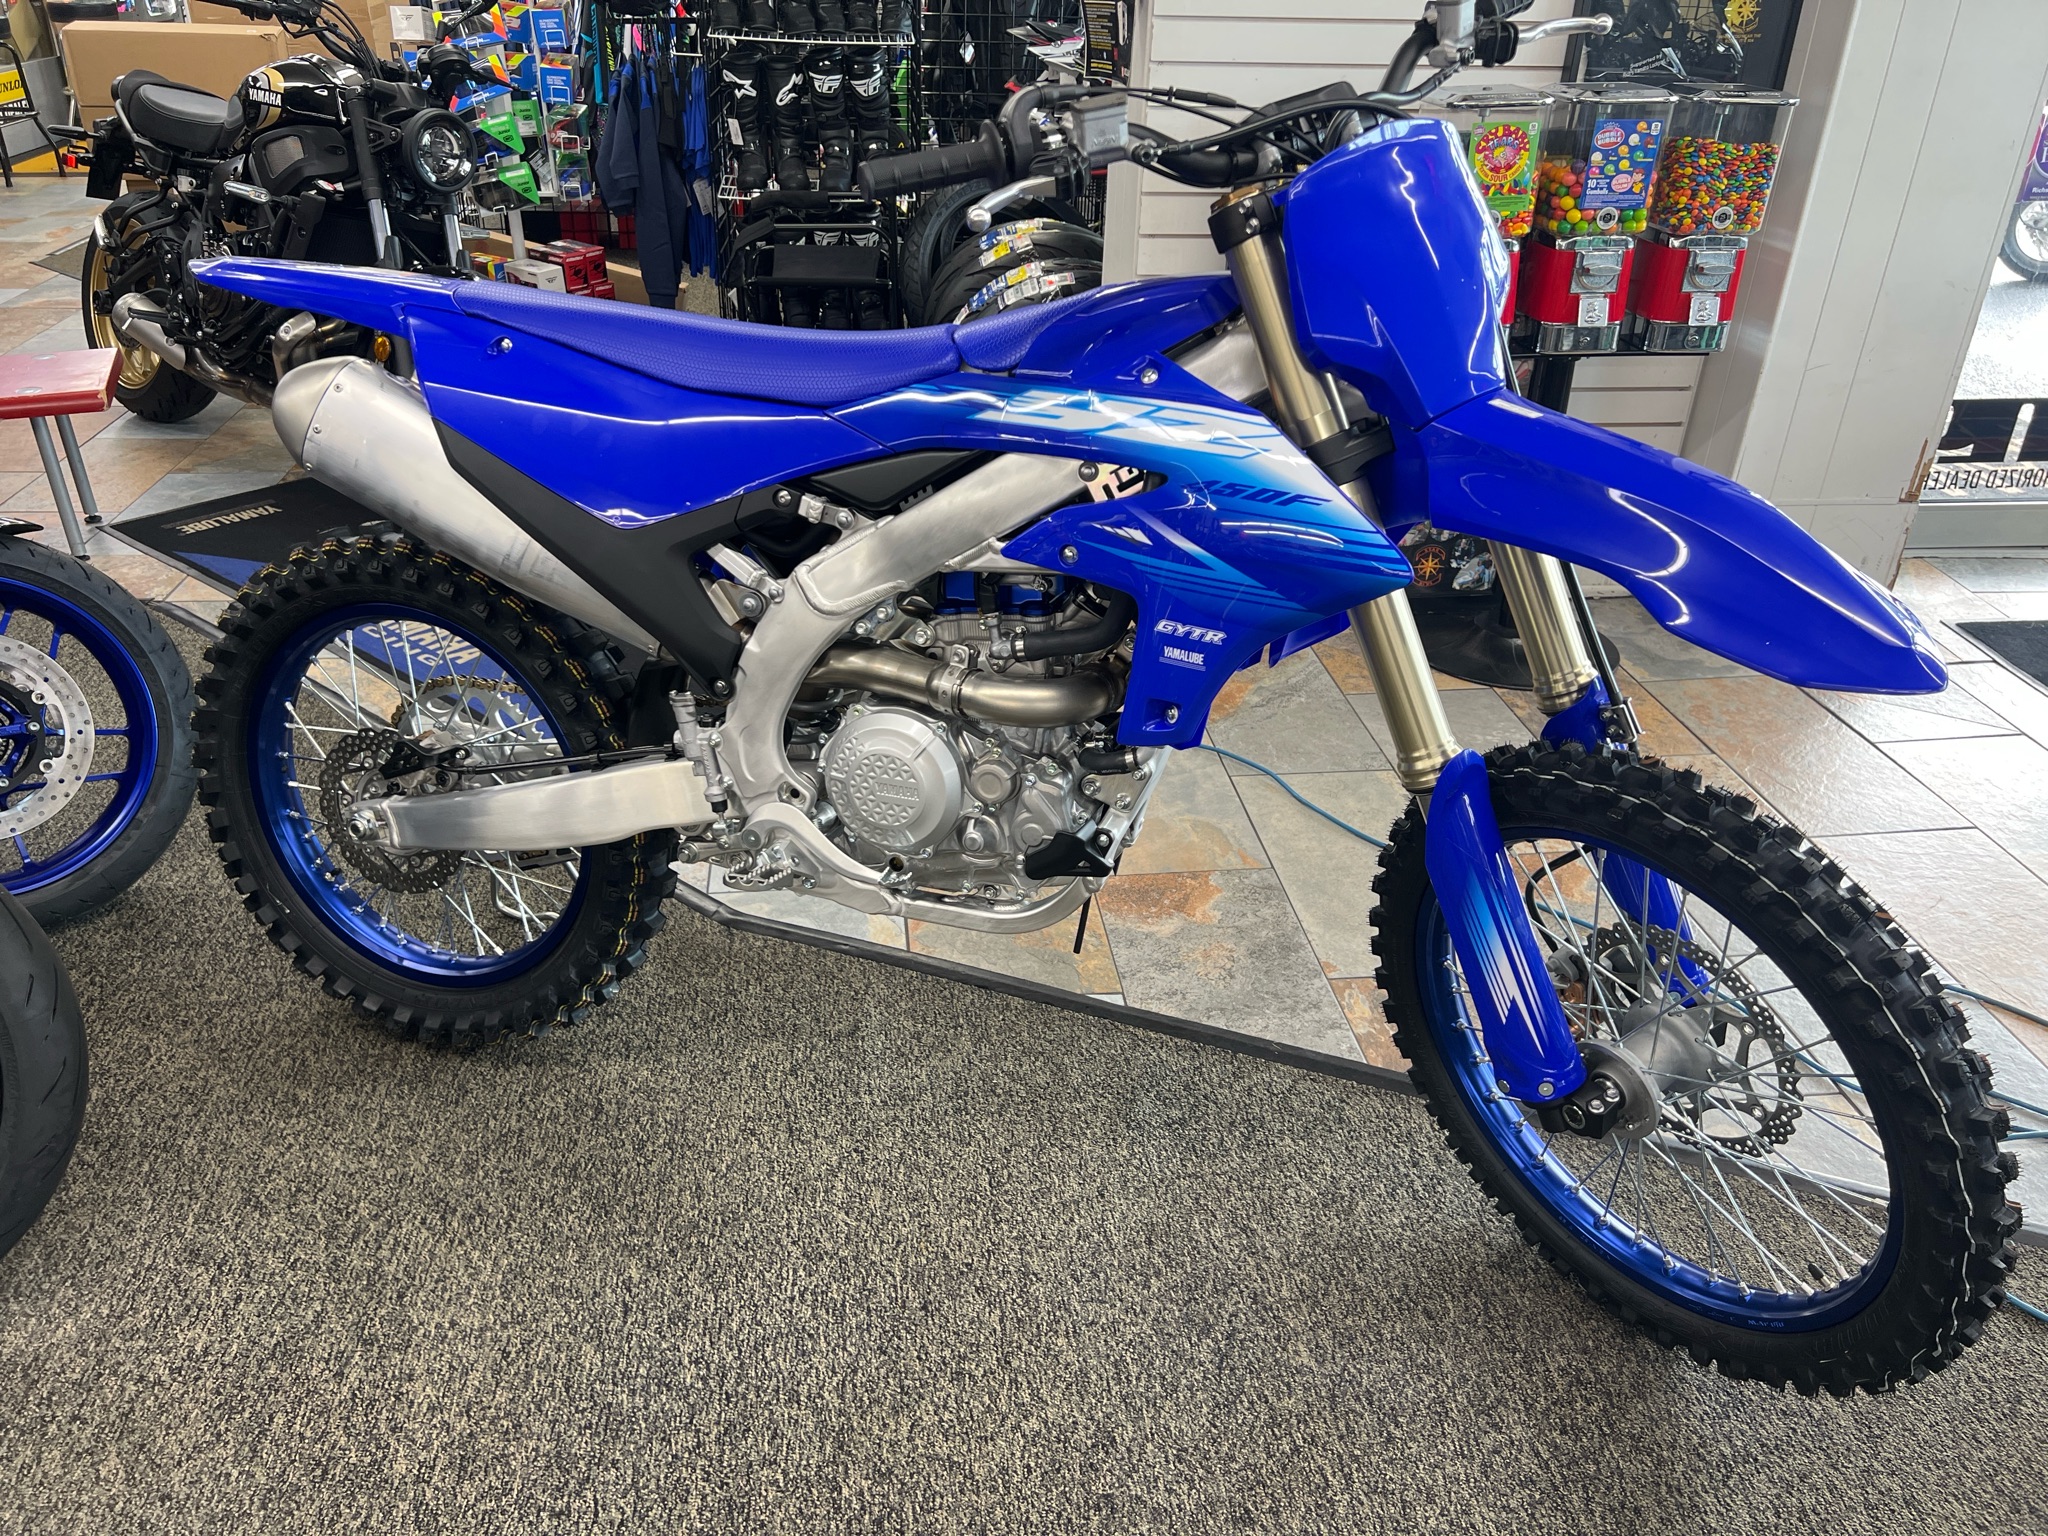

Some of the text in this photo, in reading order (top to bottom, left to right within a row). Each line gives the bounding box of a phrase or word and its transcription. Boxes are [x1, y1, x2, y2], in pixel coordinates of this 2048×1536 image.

[249, 87, 282, 106] YAMAHA
[1488, 136, 1519, 151] TEARS
[1597, 131, 1622, 140] DUBBLE
[1597, 137, 1622, 146] BUBBLE
[1489, 173, 1508, 182] SOUR
[1587, 179, 1597, 188] 10
[1181, 480, 1333, 507] 450F
[176, 506, 283, 535] YAMALUBE
[1154, 619, 1227, 645] GYTR
[1164, 646, 1204, 665] YAMALUBE
[875, 782, 919, 801] YAMAHA
